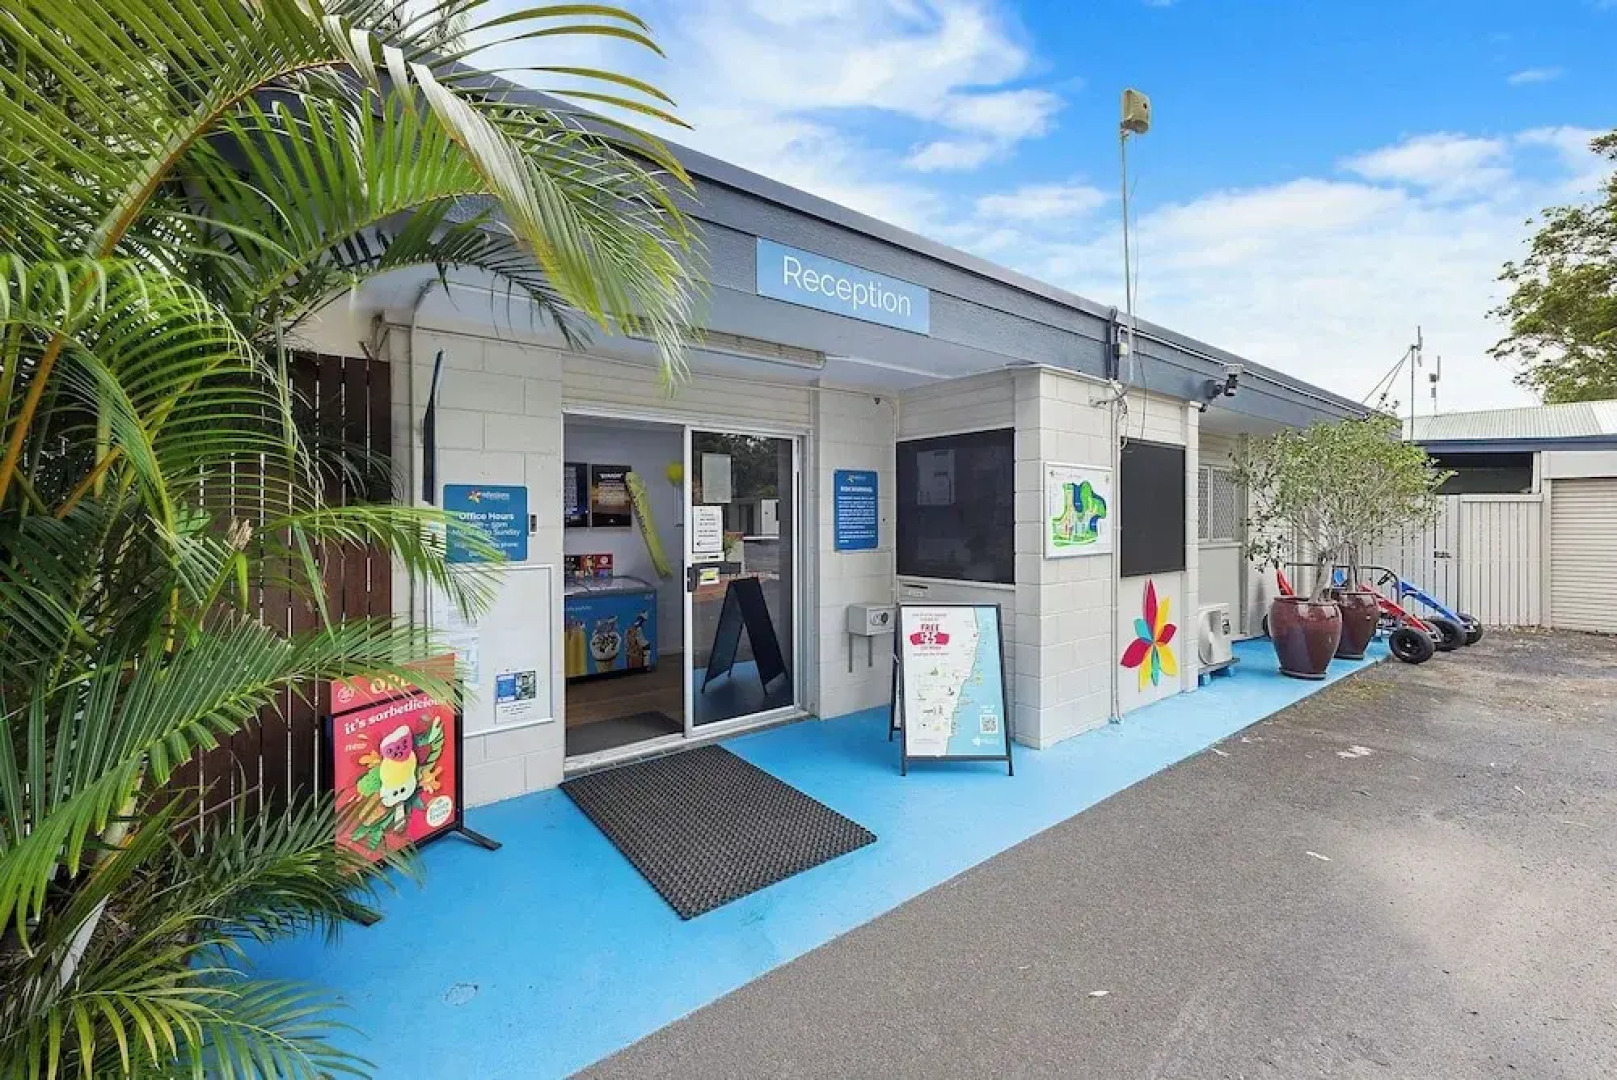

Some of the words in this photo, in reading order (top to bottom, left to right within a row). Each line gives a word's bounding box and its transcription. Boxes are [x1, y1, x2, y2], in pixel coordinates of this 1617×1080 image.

[782, 254, 912, 318] Reception
[458, 512, 487, 520] Office
[488, 511, 515, 520] Hours
[493, 529, 521, 537] Sunday
[344, 717, 367, 735] it's
[368, 696, 446, 725] sorbetlicio
